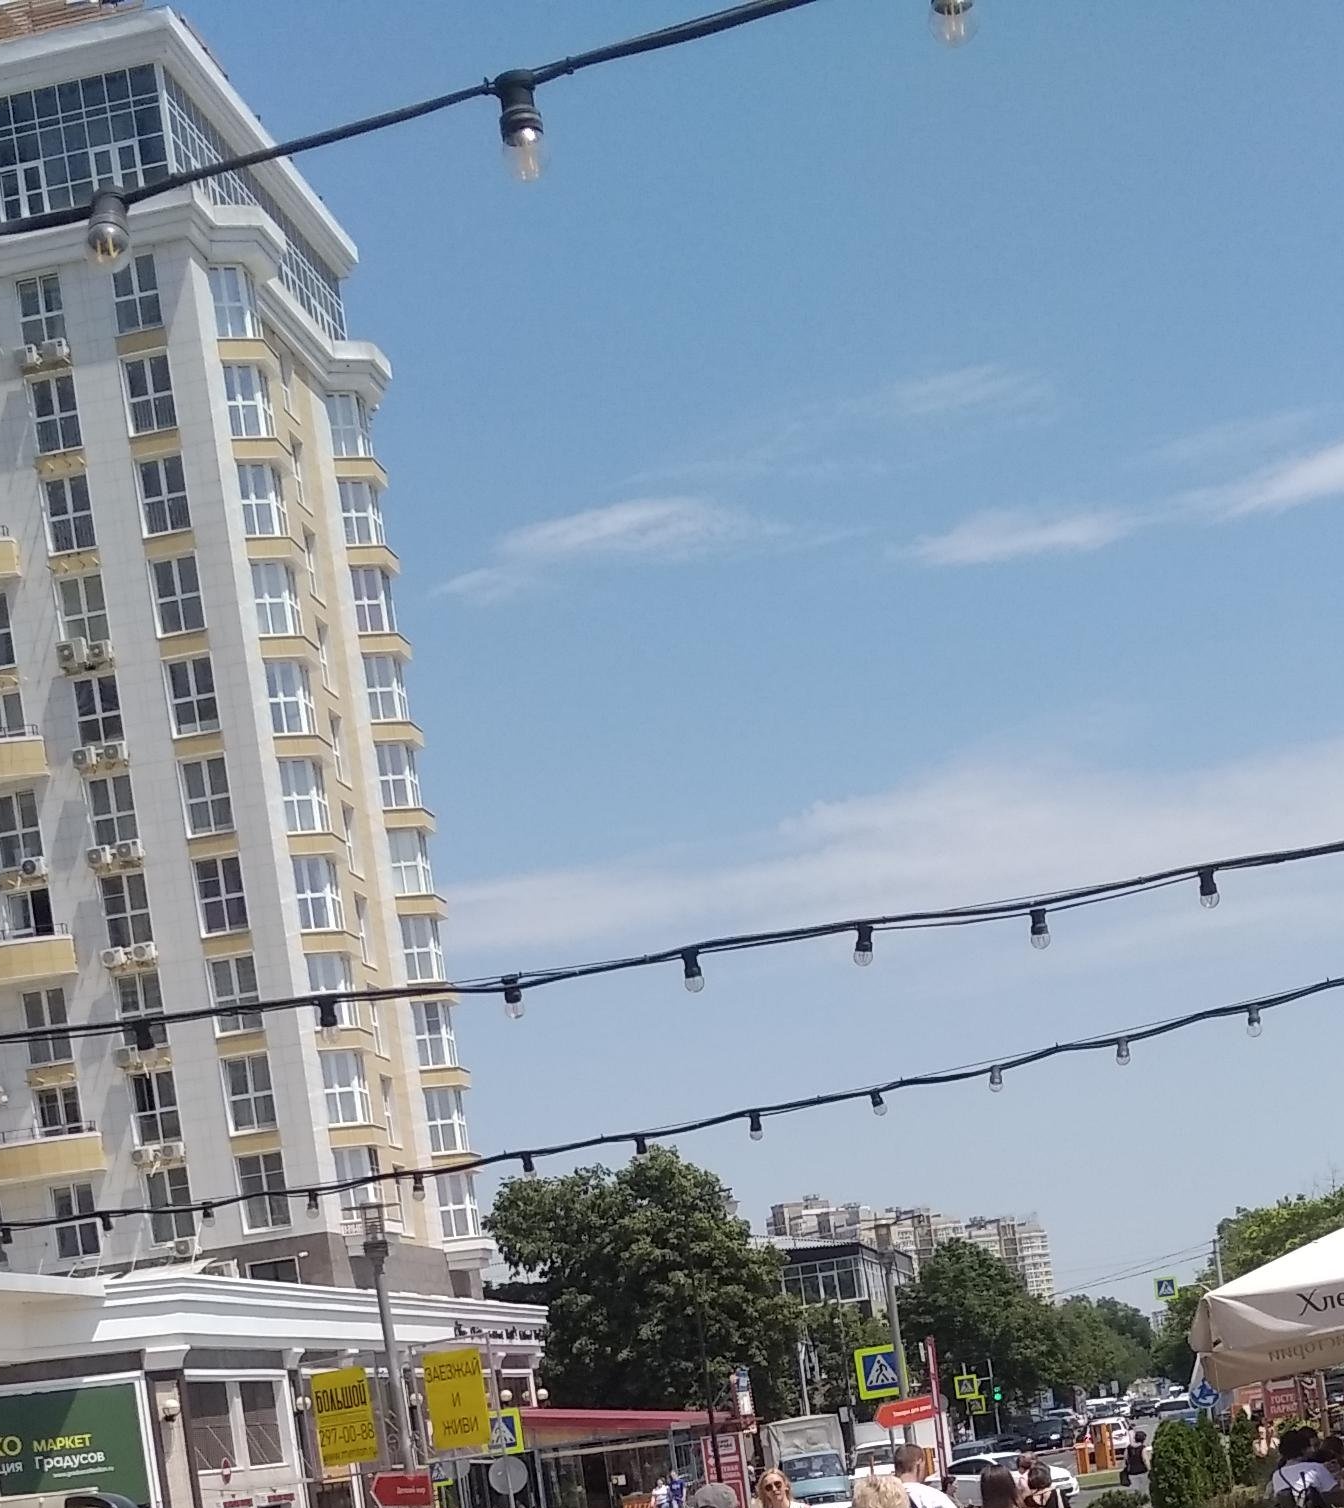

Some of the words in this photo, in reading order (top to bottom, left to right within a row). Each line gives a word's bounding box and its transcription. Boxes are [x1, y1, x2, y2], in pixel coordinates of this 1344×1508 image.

[424, 1357, 482, 1384] ЗАЕЗЖАЙ
[314, 1379, 368, 1414] БОЛЬШОЙ
[451, 1391, 462, 1408] И
[319, 1422, 375, 1448] 297-00-88
[443, 1416, 480, 1437] ЖИВИ
[32, 1433, 93, 1453] МАРКЕТ
[34, 1450, 106, 1472] Градусов
